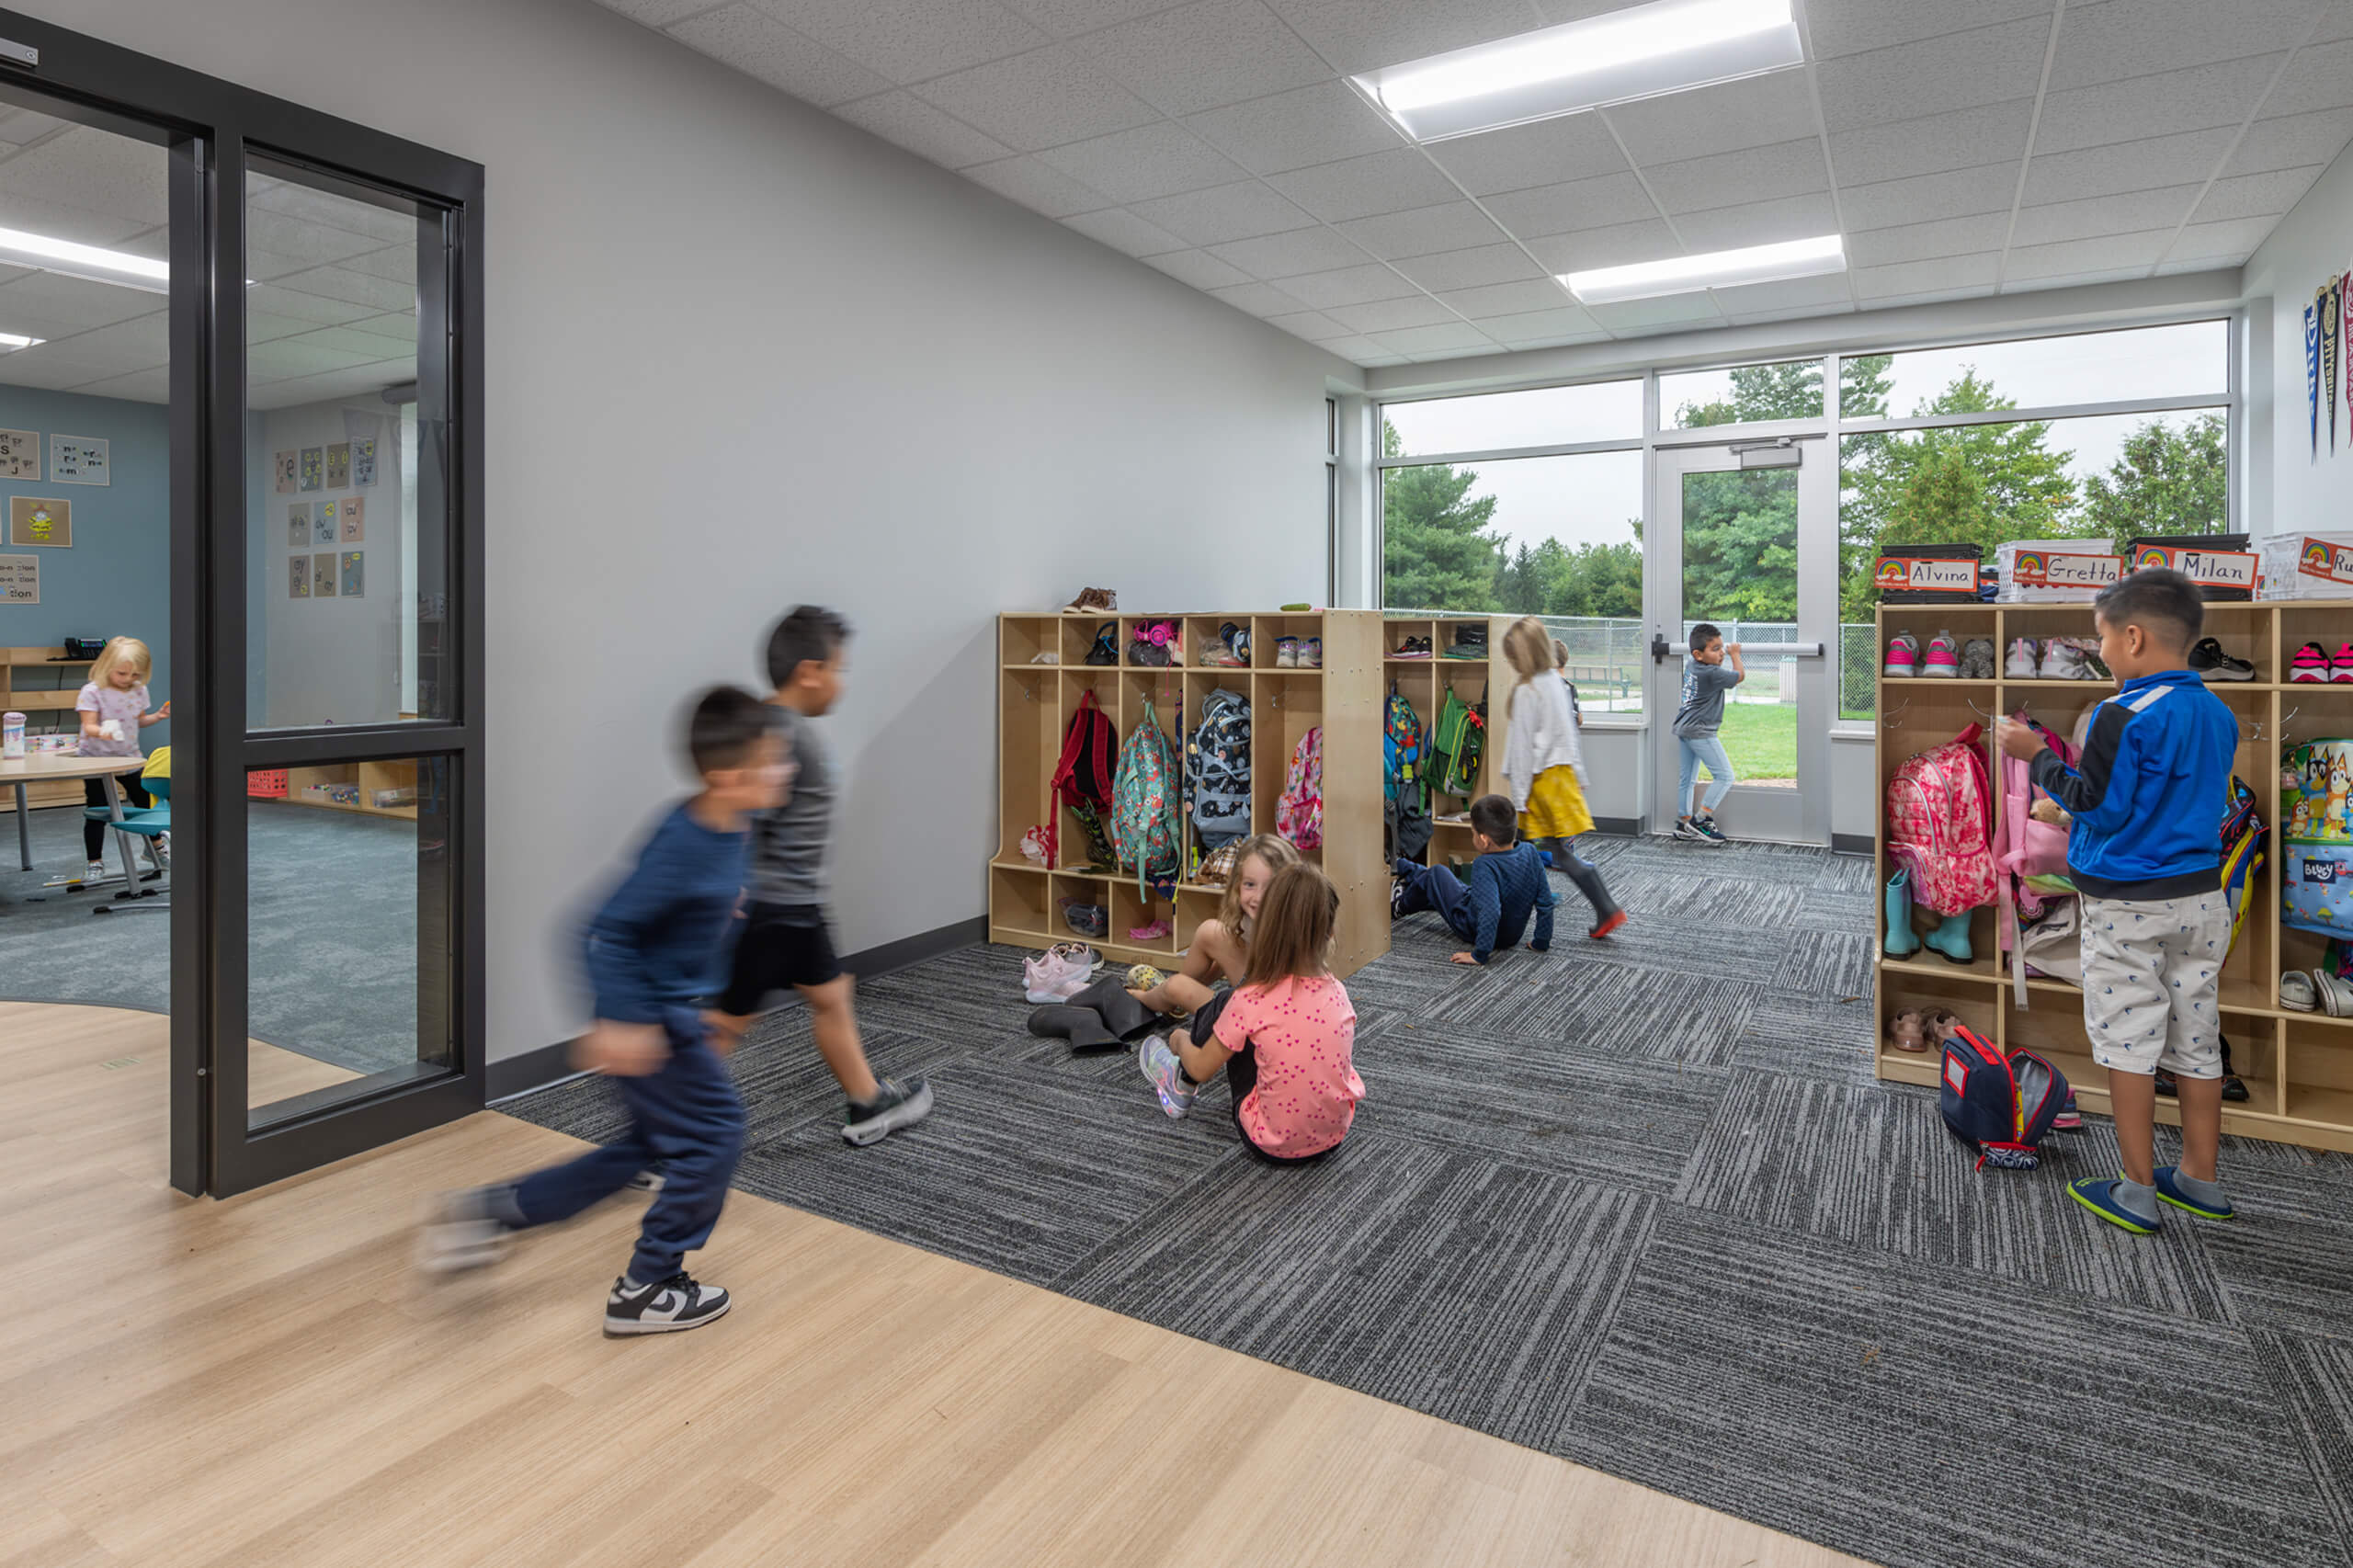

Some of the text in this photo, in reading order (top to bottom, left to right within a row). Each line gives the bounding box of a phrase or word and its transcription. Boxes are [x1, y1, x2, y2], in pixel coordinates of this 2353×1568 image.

[1912, 566, 1969, 582] Alvina
[2048, 559, 2116, 582] Gretta
[2182, 557, 2243, 580] Milan
